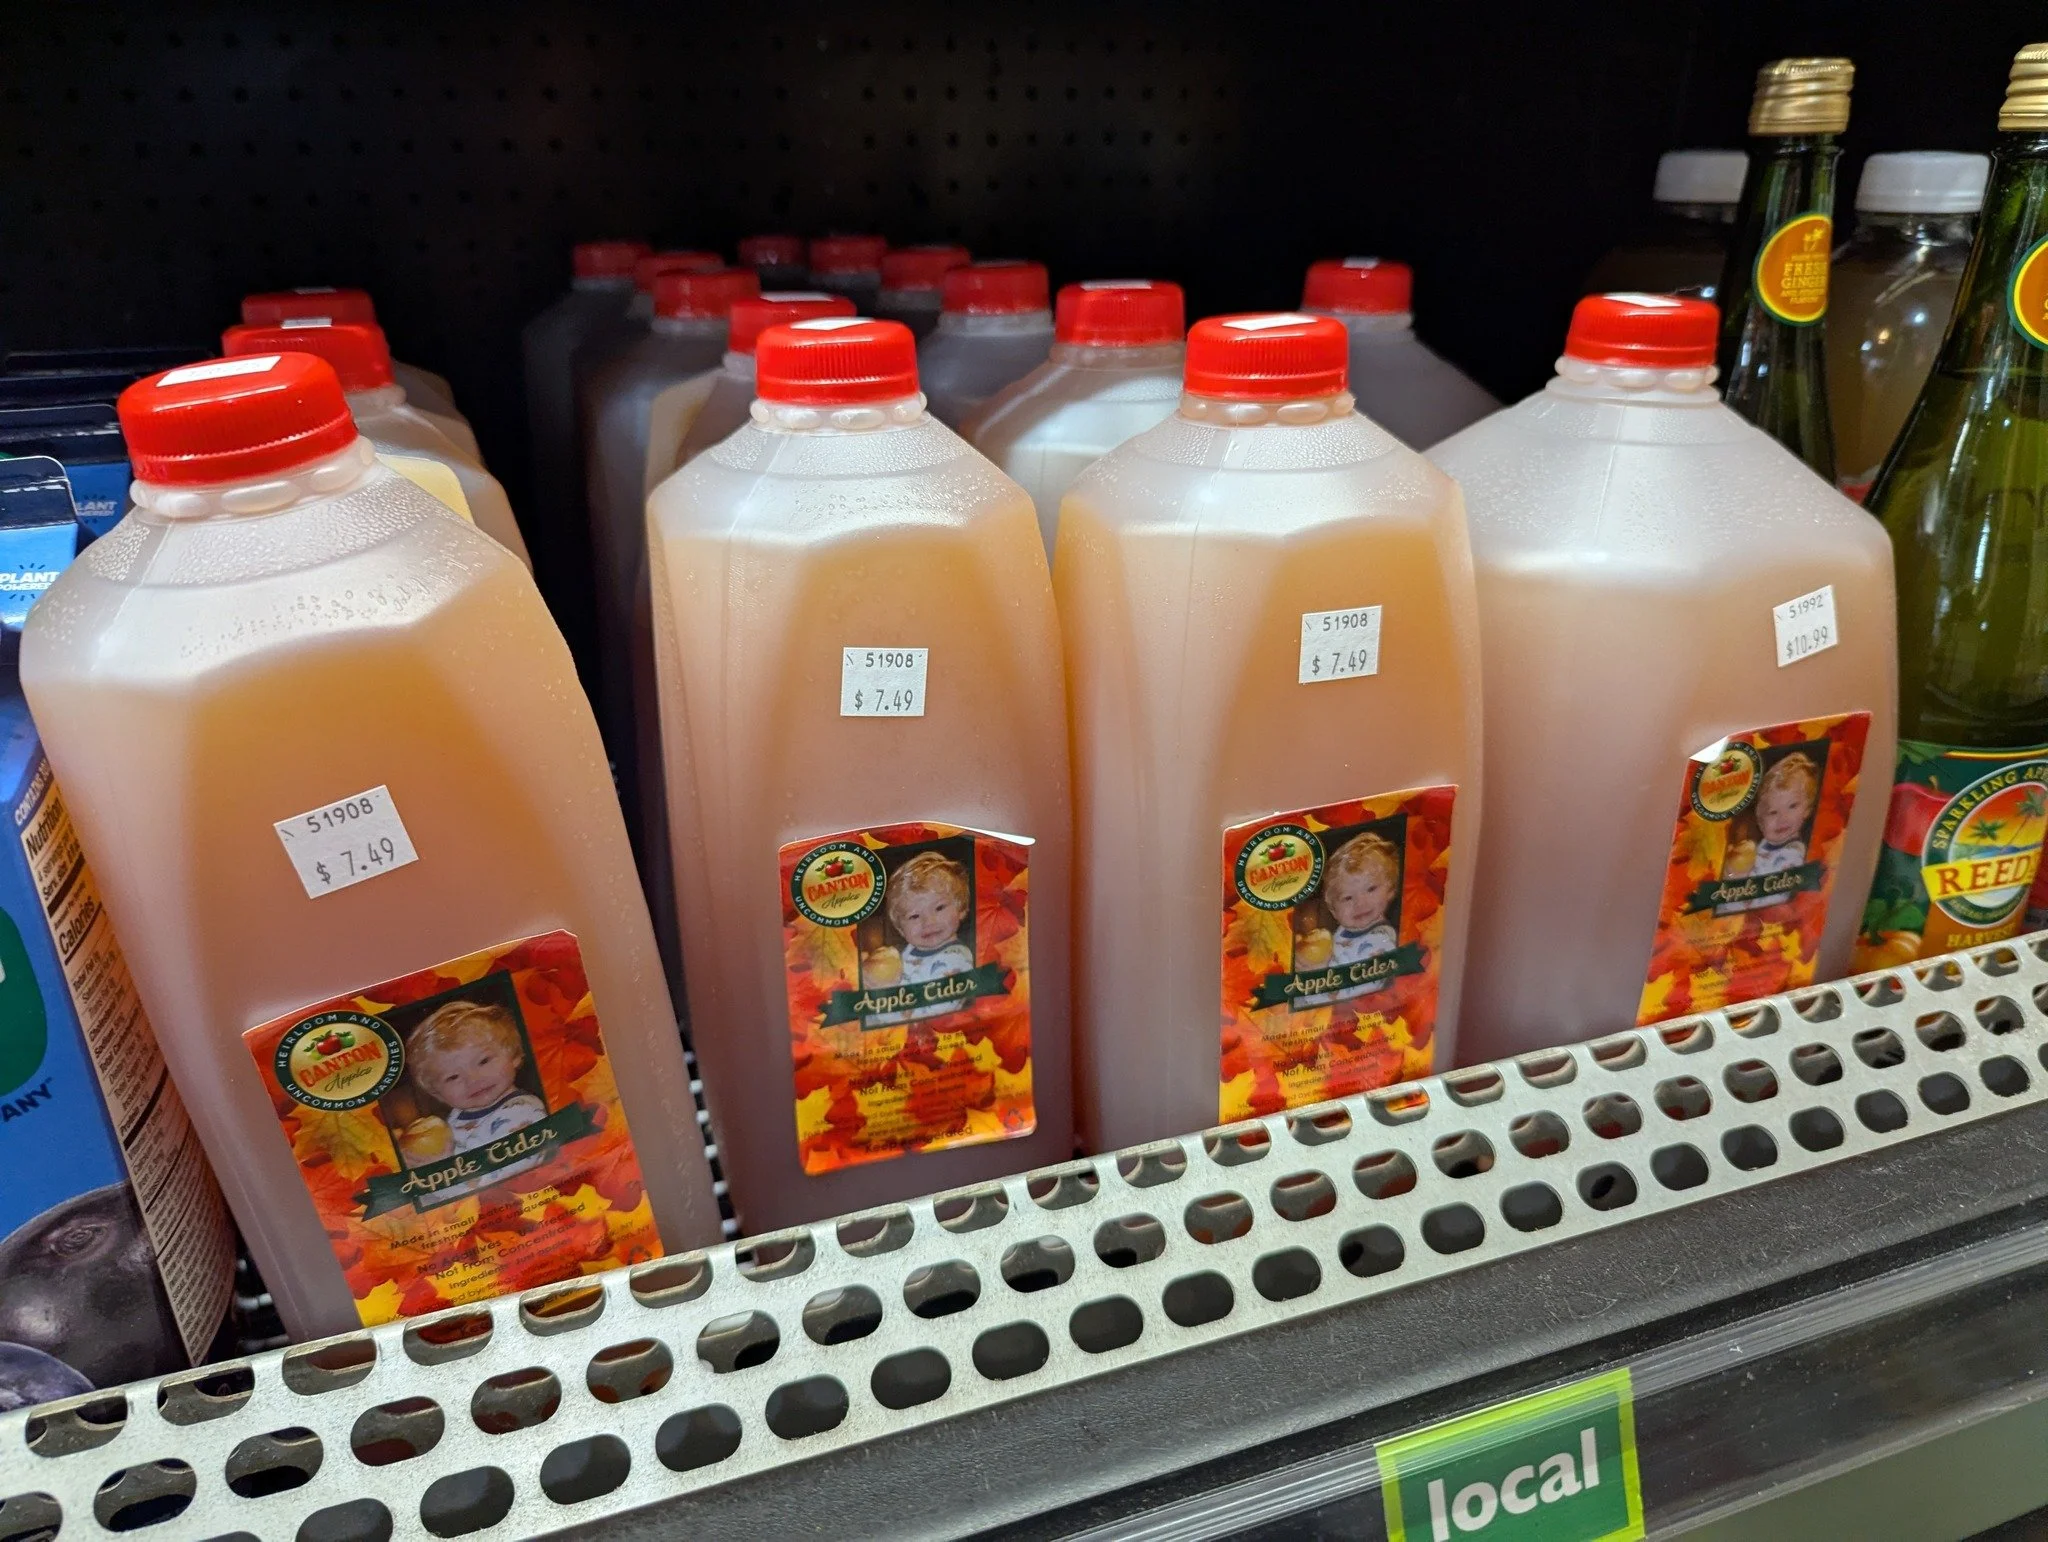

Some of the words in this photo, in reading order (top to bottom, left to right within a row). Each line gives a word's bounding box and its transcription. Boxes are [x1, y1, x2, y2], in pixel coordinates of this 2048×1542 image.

[76, 501, 117, 511] LANT
[1323, 613, 1368, 632] 51908
[1789, 594, 1823, 619] 51992
[865, 652, 913, 668] 51908
[1786, 626, 1828, 659] $10.99
[306, 798, 374, 833] 51908
[1932, 770, 2018, 850] SPARKLING
[794, 843, 847, 881] HEIRLOOM
[853, 846, 875, 863] AND
[1237, 826, 1291, 867] HEIRLOOM
[1296, 830, 1315, 845] AND
[806, 871, 870, 903] CANTON
[1237, 880, 1287, 909] UNCOMMON
[1291, 857, 1322, 903] VARIETIES
[1249, 855, 1309, 887] CANTON
[1710, 879, 1758, 902] Apple
[1762, 871, 1804, 892] Cider
[795, 895, 850, 925] UNCOMMON
[854, 874, 884, 920] VARIETIES
[58, 895, 96, 956] Calories
[853, 988, 918, 1013] Apple
[923, 976, 978, 1001] Cider
[1284, 968, 1344, 995] Apple
[1349, 955, 1399, 982] Cider
[278, 1014, 338, 1068] HEIRLOOM
[349, 1014, 381, 1030] AND
[286, 1083, 367, 1109] UNCOMMON
[371, 1040, 400, 1096] VARIETIES
[299, 1040, 383, 1088] CANTON
[1283, 1066, 1299, 1078] Not
[400, 1156, 482, 1194] Apple
[485, 1126, 558, 1165] Cider
[390, 1234, 425, 1250] Made
[428, 1230, 440, 1239] in
[443, 1216, 475, 1233] small
[527, 1192, 539, 1200] to
[417, 1263, 436, 1274] No
[538, 1202, 586, 1229] Treated
[435, 1267, 459, 1281] Not
[462, 1256, 495, 1272] From
[497, 1220, 577, 1258] Concentrate
[1427, 1427, 1600, 1542] local
